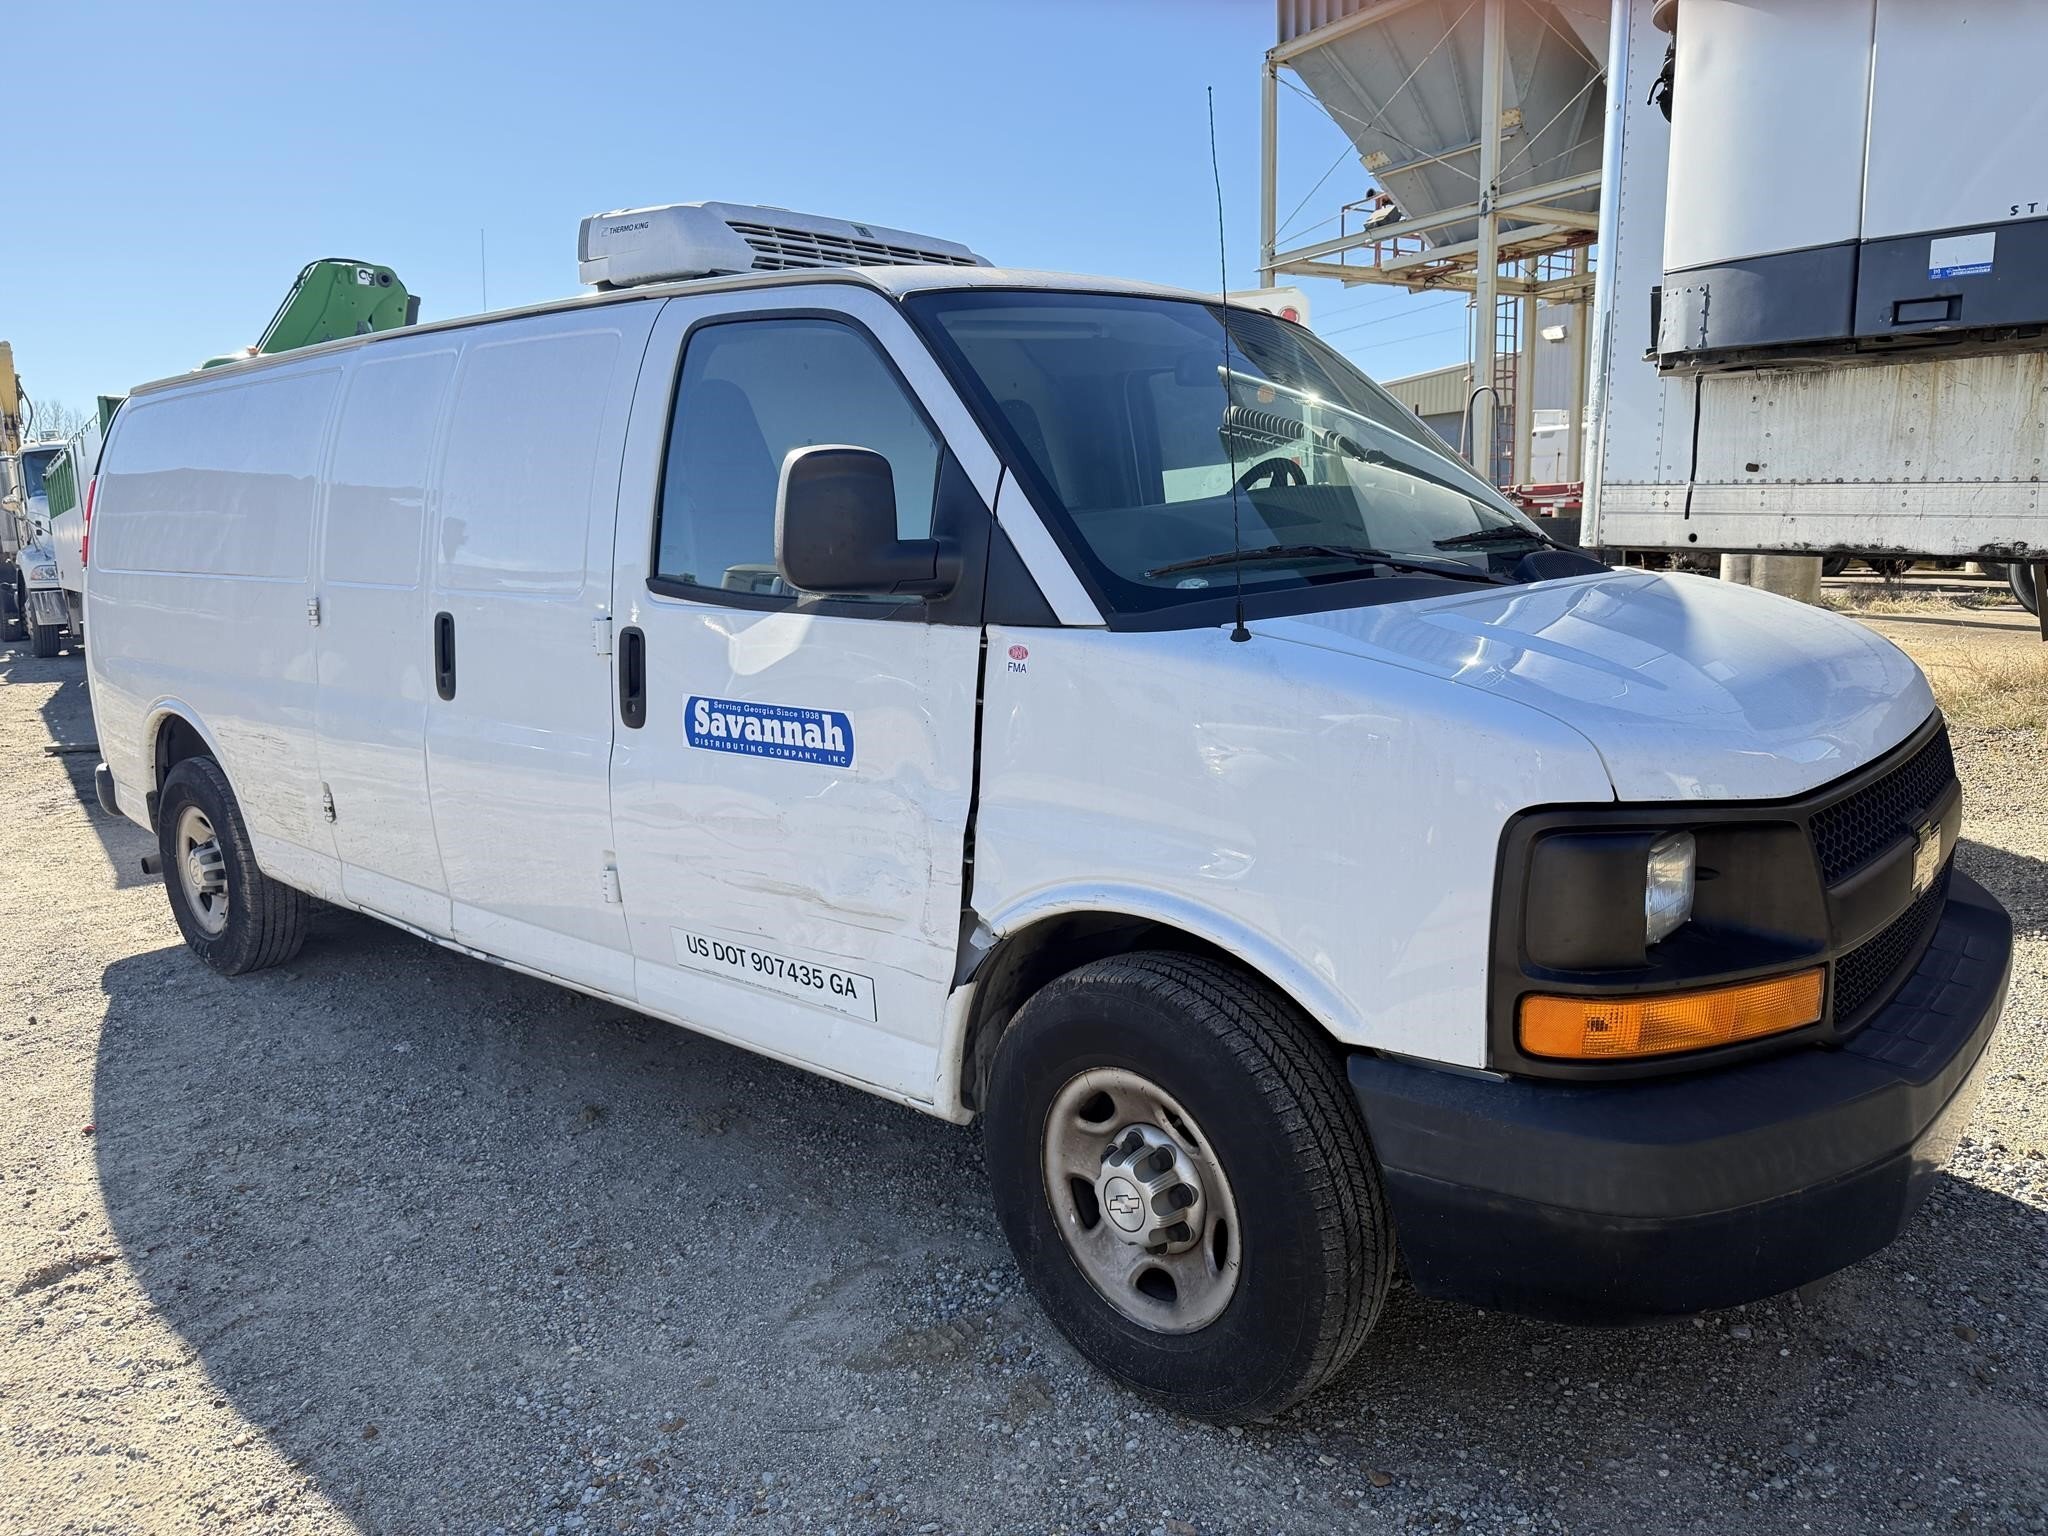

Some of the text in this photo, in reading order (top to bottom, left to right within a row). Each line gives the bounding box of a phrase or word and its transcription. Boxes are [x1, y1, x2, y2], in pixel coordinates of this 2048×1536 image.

[2010, 202, 2048, 216] ST
[609, 221, 649, 234] THERMO KING
[1007, 661, 1027, 673] FMA
[713, 701, 820, 720] Serving Georgia Since 1938
[694, 699, 845, 751] Savannah
[694, 737, 847, 764] DISTRIBUTING COMPANY, INC
[686, 934, 710, 957] US
[712, 941, 746, 968] DOT
[750, 952, 825, 989] 907435
[829, 973, 858, 999] GA
